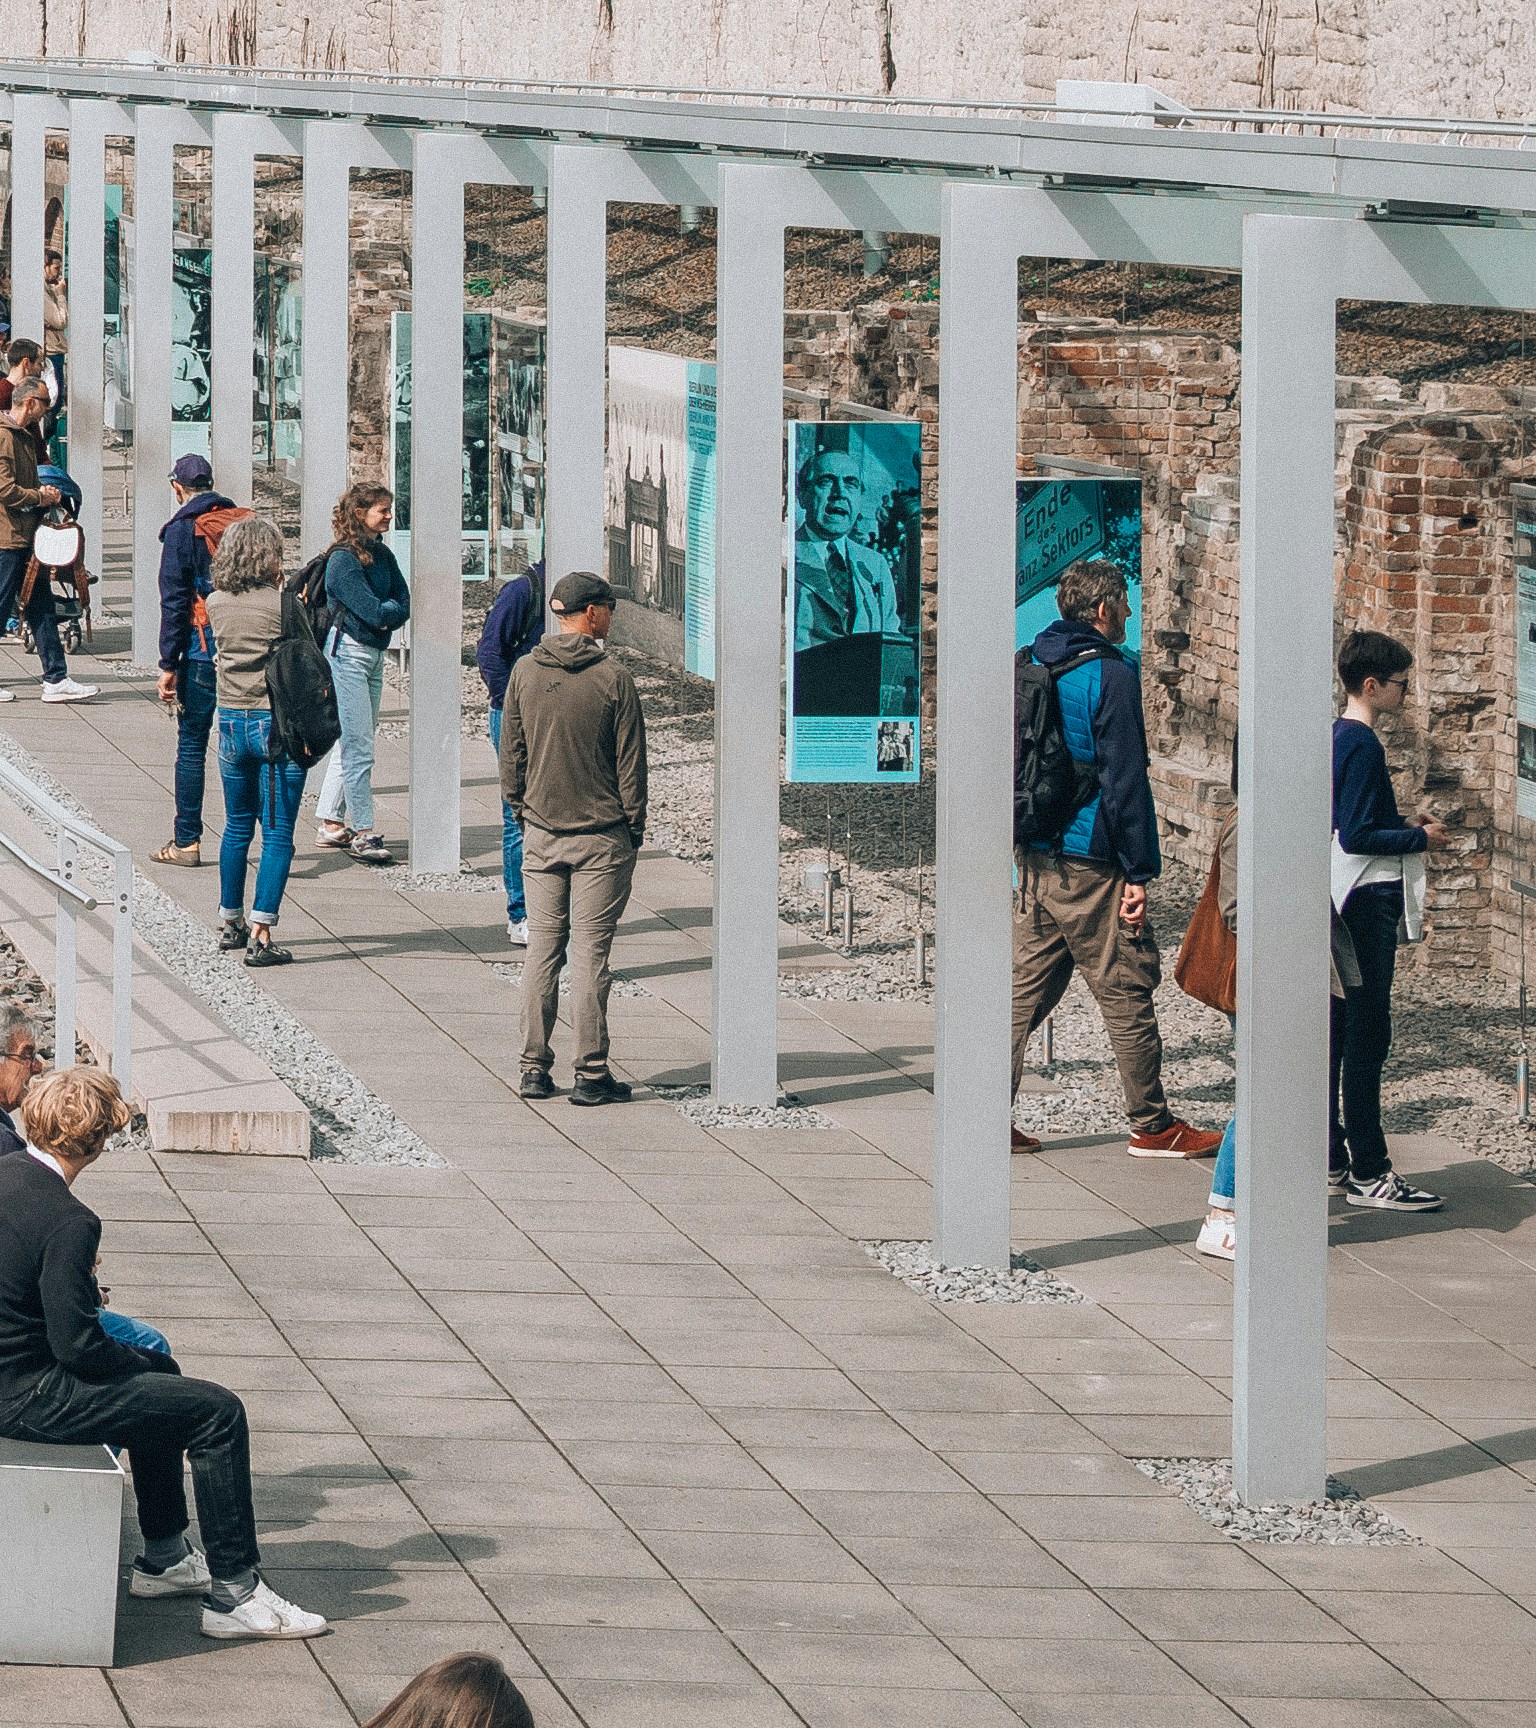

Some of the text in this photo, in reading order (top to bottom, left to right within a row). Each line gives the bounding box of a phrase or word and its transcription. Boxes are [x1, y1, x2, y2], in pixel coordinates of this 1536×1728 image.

[1024, 483, 1071, 540] Ende
[1037, 522, 1057, 544] des
[1017, 515, 1094, 586] anz. Sektors
